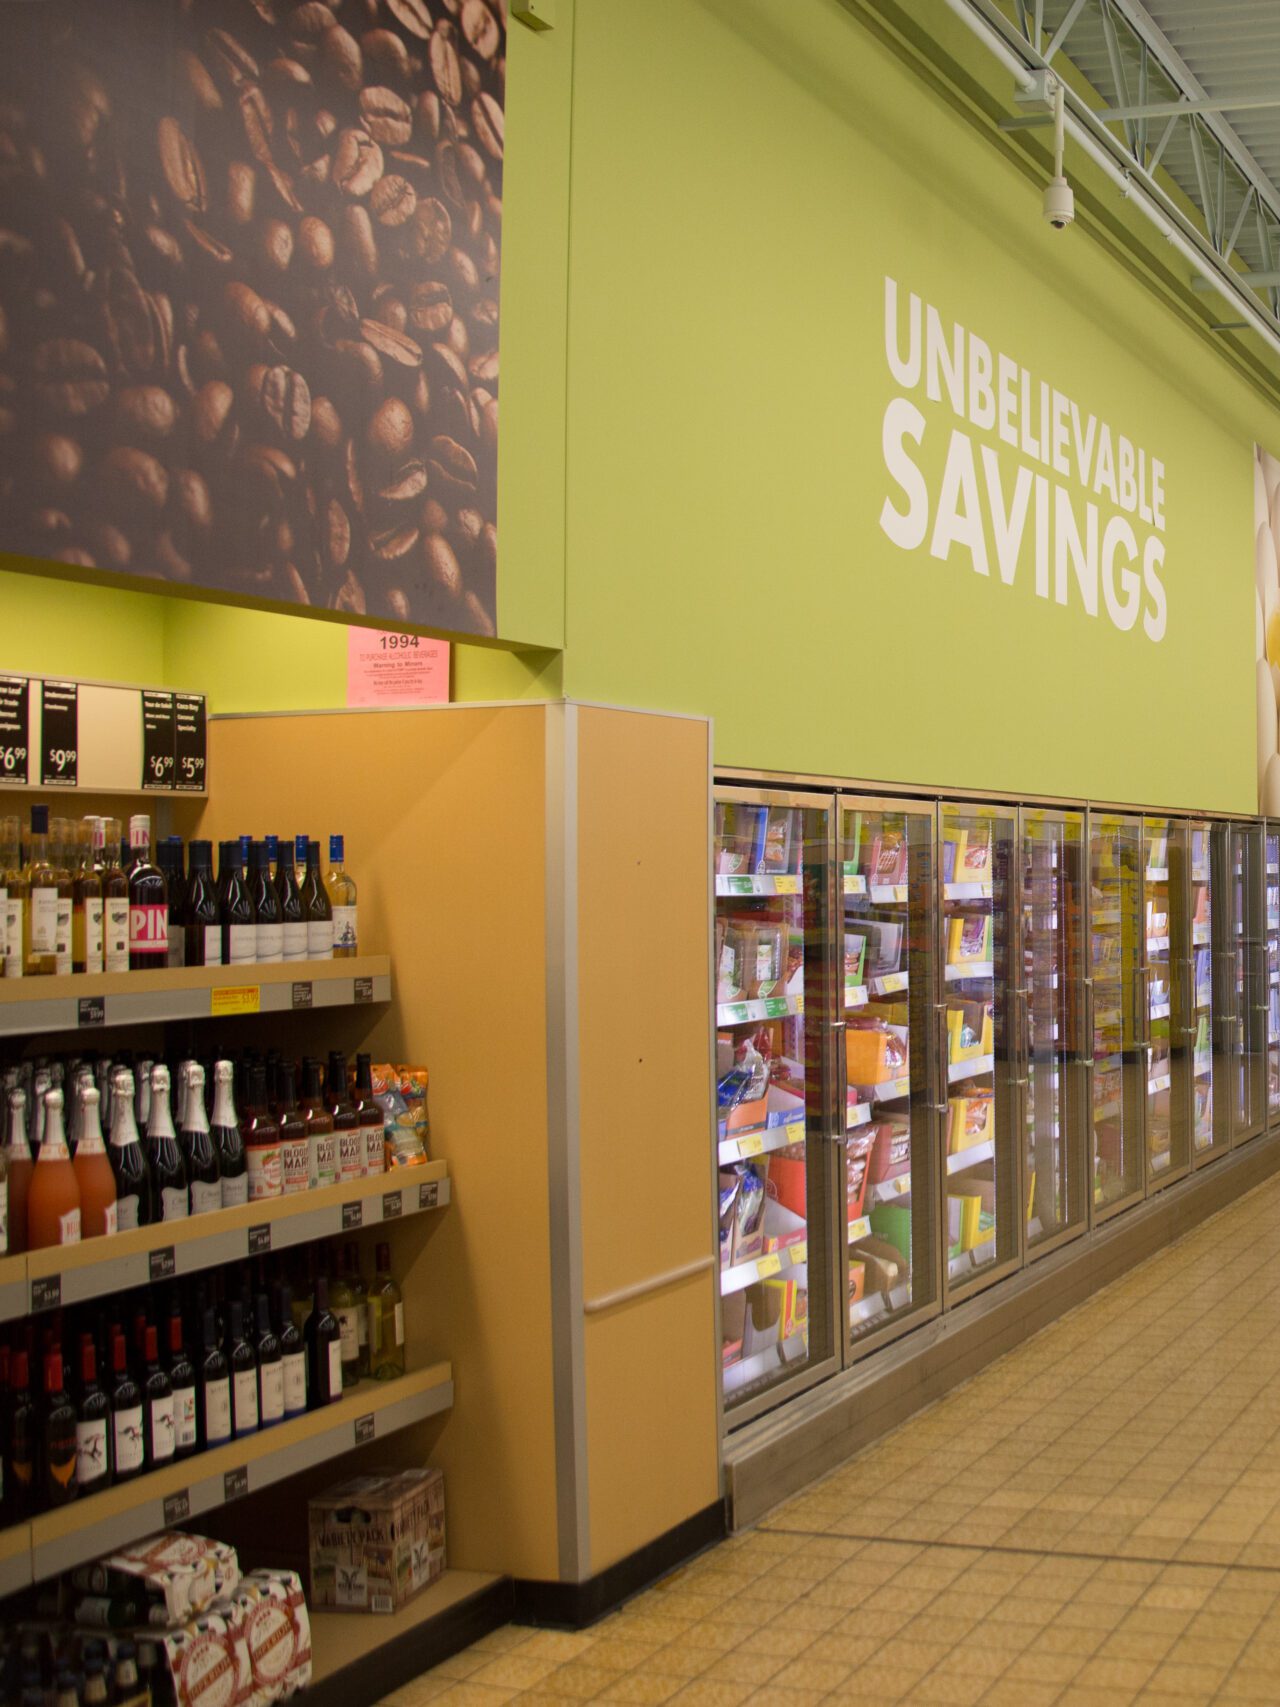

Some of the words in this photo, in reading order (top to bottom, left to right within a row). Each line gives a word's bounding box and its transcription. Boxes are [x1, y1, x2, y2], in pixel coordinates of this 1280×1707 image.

[879, 397, 1167, 642] SAVINGS
[885, 275, 1165, 532] UNBELIEVABLE
[380, 635, 420, 650] 1994
